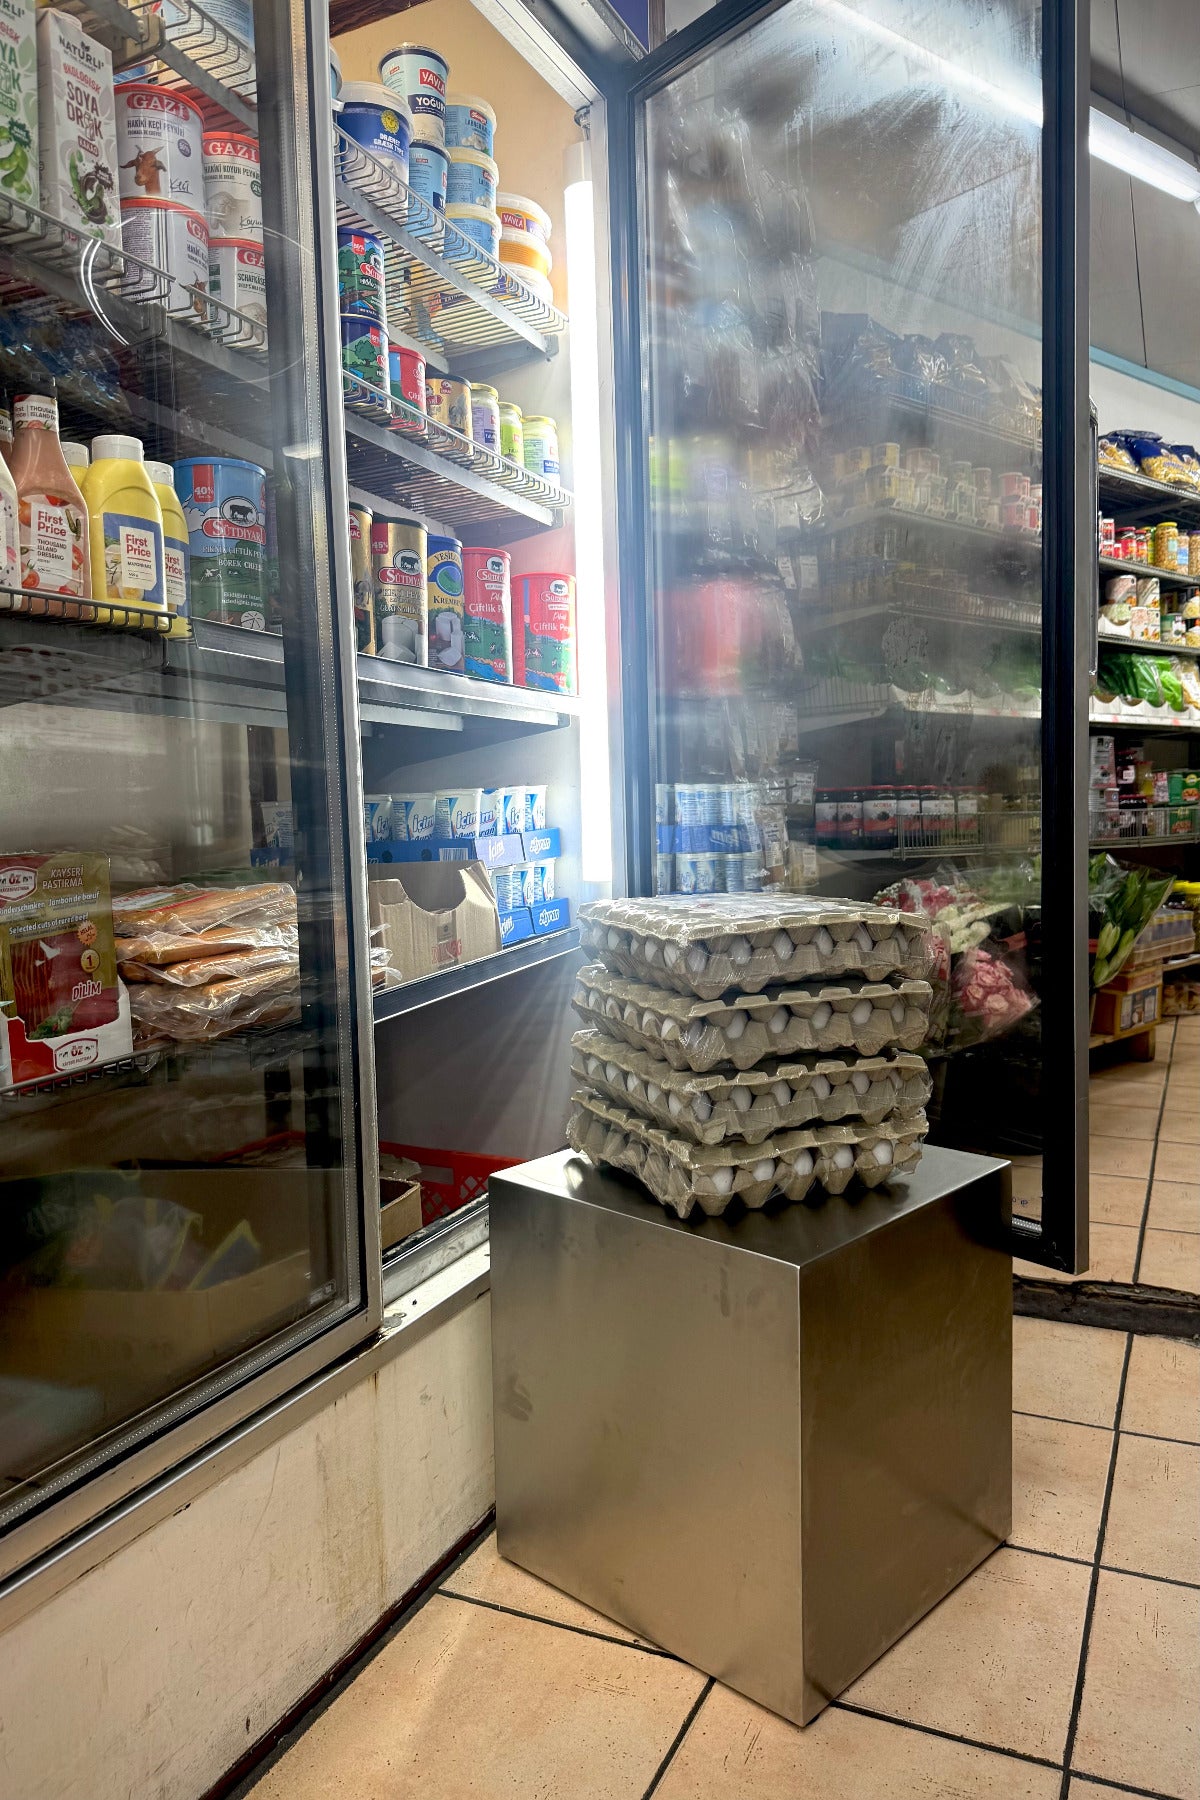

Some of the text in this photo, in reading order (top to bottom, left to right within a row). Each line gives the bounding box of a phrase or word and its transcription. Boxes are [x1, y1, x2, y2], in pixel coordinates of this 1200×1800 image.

[421, 71, 445, 94] YAYLA
[66, 81, 100, 117] SOYA
[208, 141, 258, 162] GAZI
[503, 213, 524, 228] YAYLA
[38, 510, 63, 526] First
[37, 521, 67, 537] Price
[38, 538, 67, 550] THOUSAND
[125, 533, 148, 547] First
[37, 545, 58, 553] ISLAND
[37, 551, 65, 560] DRESSING
[126, 544, 152, 558] Price
[469, 603, 496, 615] Çiftlik
[533, 622, 557, 633] Çiftlik
[51, 865, 83, 878] KAYSERİ
[42, 878, 83, 890] PASTIRMA
[49, 897, 72, 906] Jambon
[82, 890, 100, 900] bœuf
[9, 922, 37, 934] Selected
[37, 920, 51, 928] cuts
[51, 918, 58, 926] of
[86, 955, 92, 967] 1
[72, 980, 102, 1001] DİLİM
